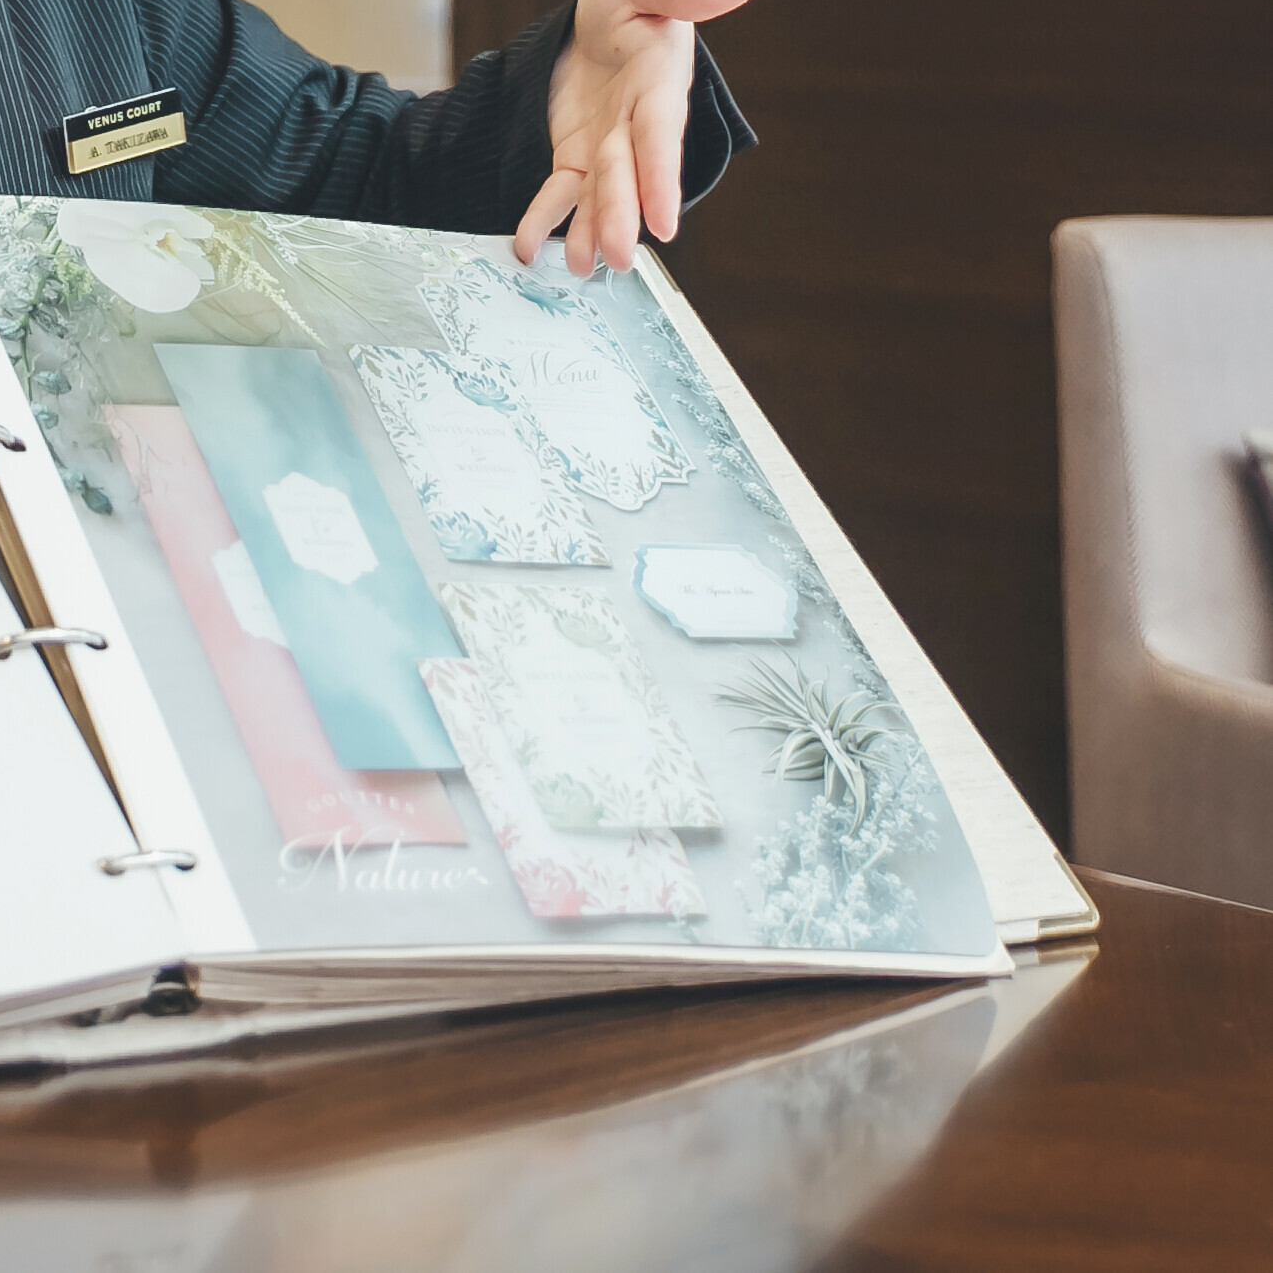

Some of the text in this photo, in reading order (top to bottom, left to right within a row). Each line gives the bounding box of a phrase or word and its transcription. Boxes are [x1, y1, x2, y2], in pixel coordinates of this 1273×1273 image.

[87, 100, 162, 130] VENUS COURT
[508, 350, 602, 388] Menu
[278, 825, 488, 891] Nature
